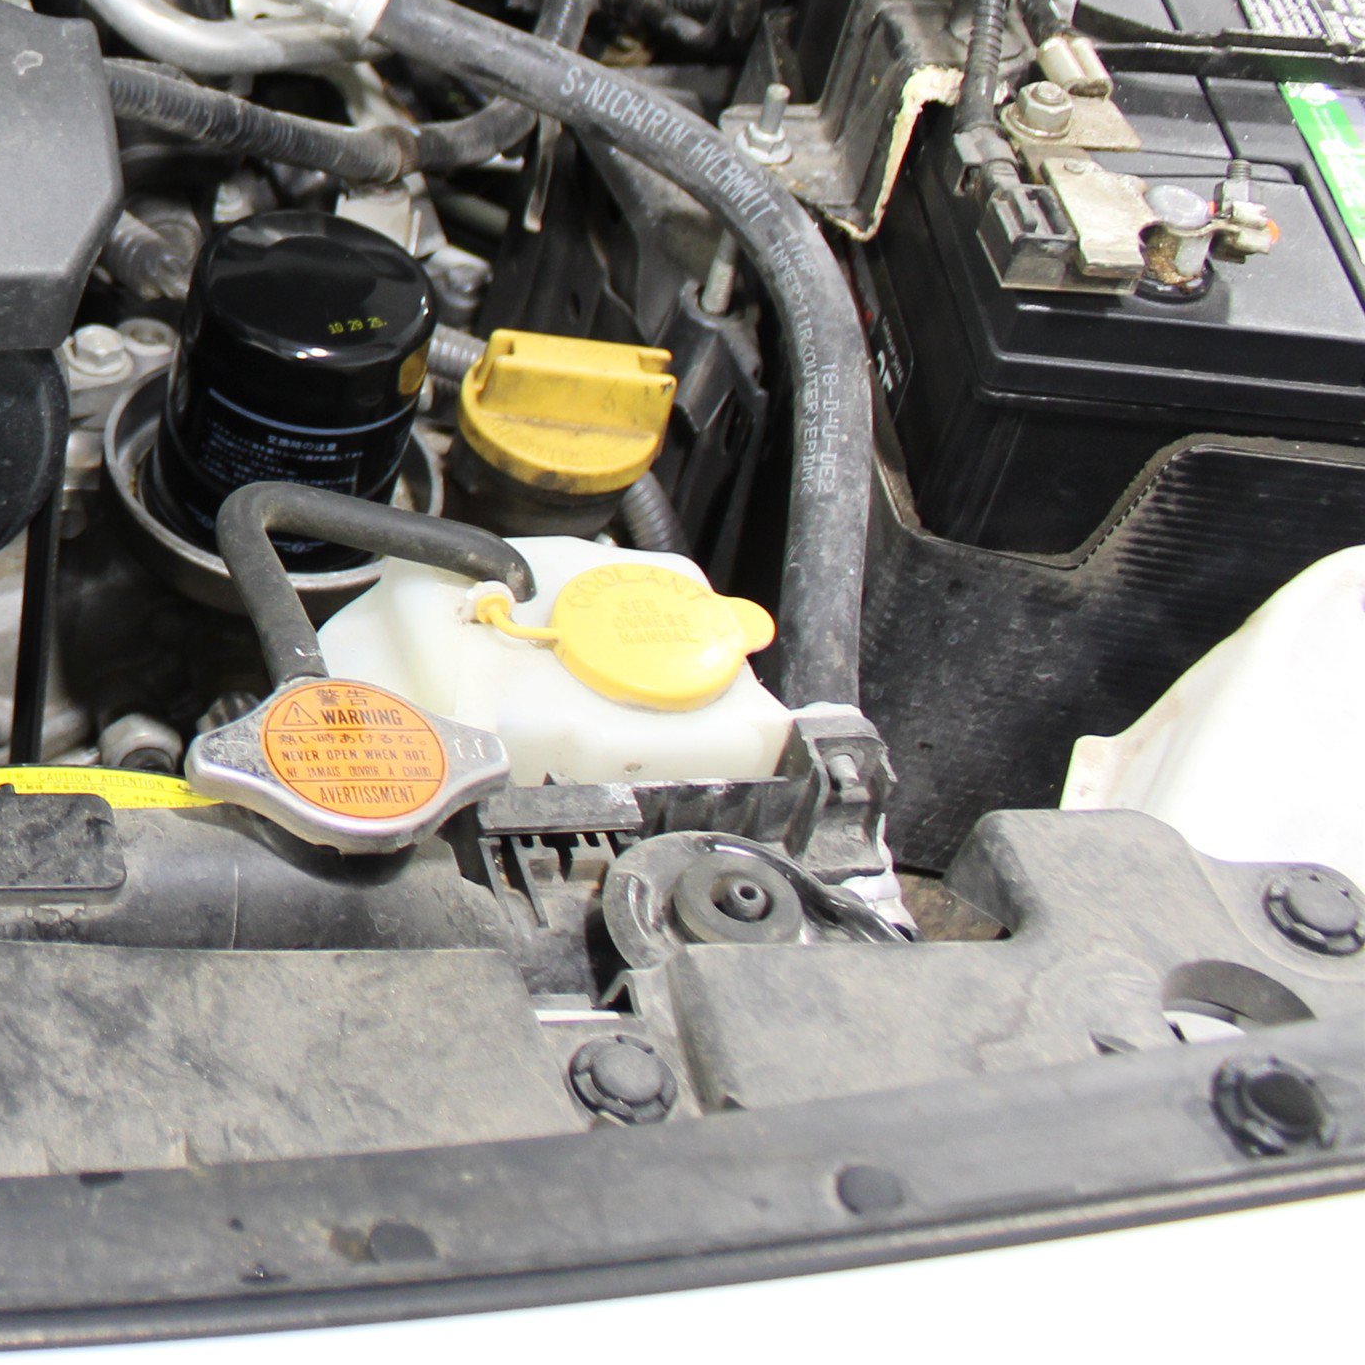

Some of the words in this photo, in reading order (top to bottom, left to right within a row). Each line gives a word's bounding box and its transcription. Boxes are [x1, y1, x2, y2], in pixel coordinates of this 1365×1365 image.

[565, 566, 713, 609] COOLANT
[320, 708, 403, 726] WARNING
[281, 749, 321, 762] NEVER
[326, 749, 358, 761] OPEN
[364, 749, 398, 761] WHEN
[37, 771, 91, 783] CAUTION
[101, 774, 165, 790] ATTENTION
[286, 766, 299, 778] NE
[306, 766, 341, 778] JAMAIS
[348, 765, 380, 777] OUVRIR
[319, 786, 417, 804] AVERTISSMENT
